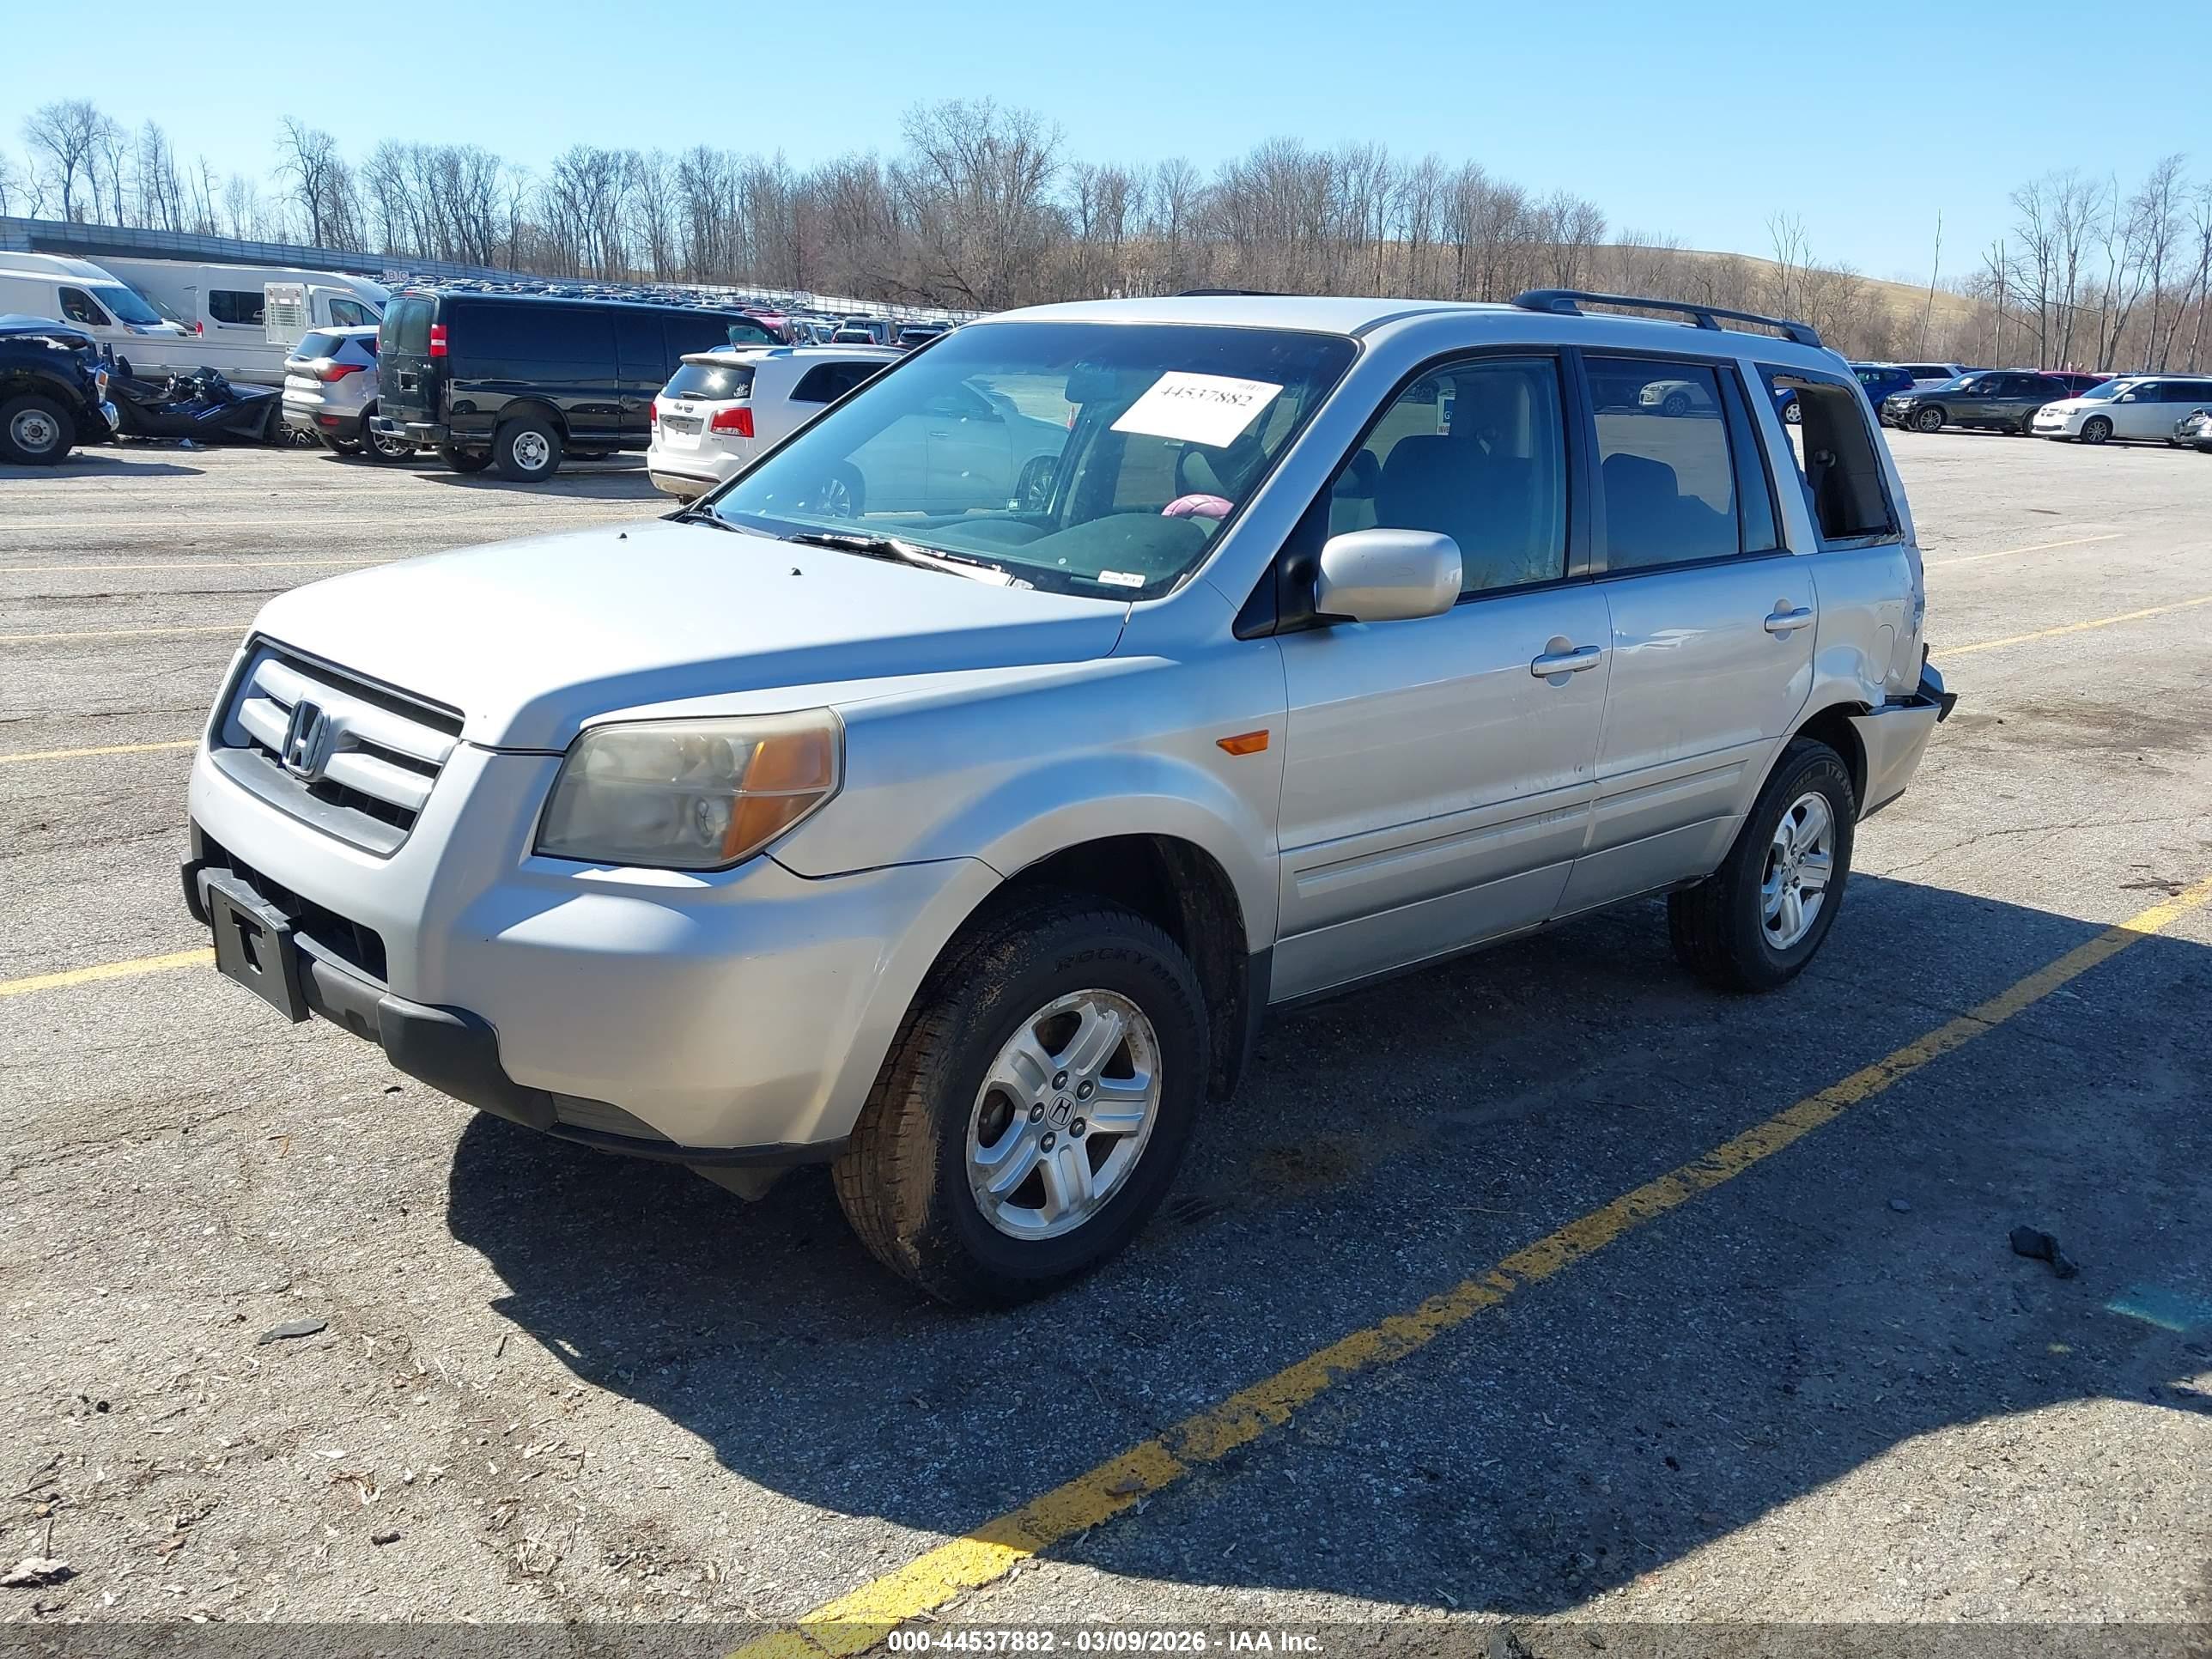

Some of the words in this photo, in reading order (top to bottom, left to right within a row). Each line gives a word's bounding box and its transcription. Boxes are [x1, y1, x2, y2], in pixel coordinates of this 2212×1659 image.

[389, 271, 396, 280] B
[400, 271, 409, 280] C
[1160, 386, 1254, 406] 44537882
